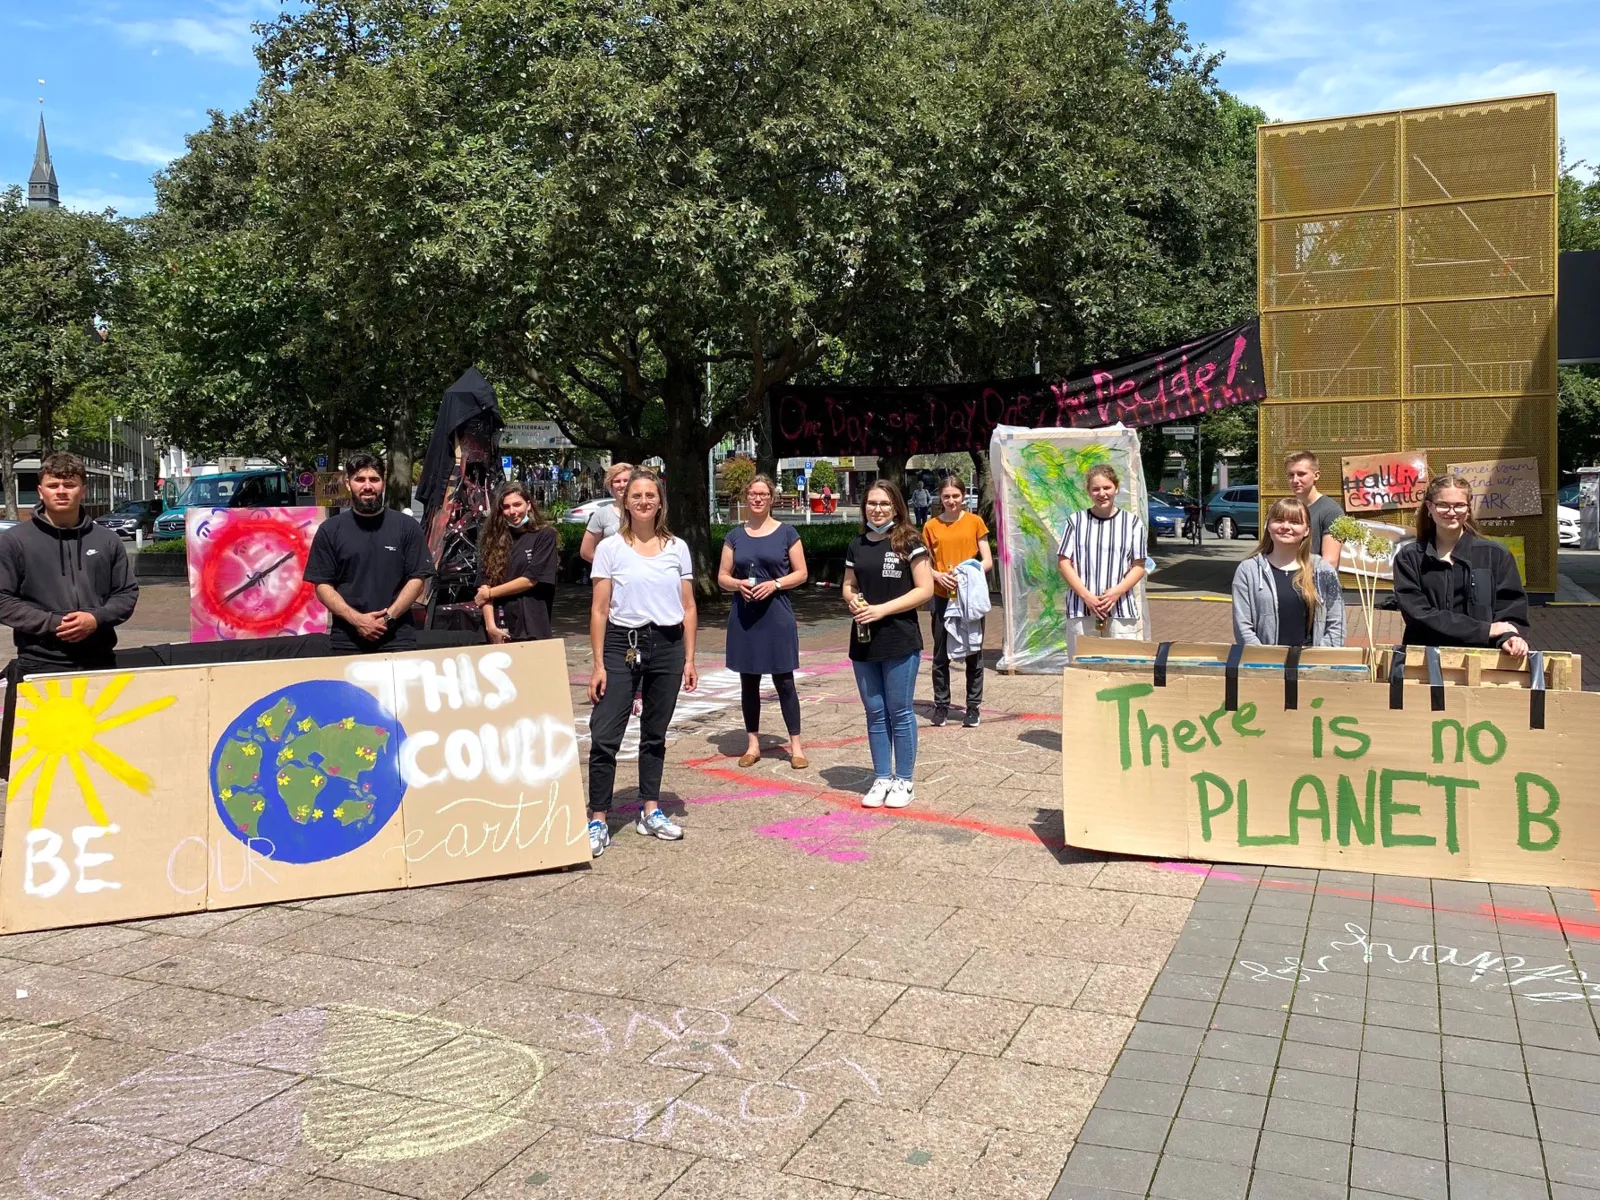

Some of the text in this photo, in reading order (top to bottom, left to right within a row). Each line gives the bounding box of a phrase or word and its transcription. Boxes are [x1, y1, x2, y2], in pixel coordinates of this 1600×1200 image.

[1093, 335, 1246, 424] Decide!
[1349, 486, 1426, 507] esmatte
[1468, 476, 1493, 487] ind
[1469, 493, 1512, 510] TARK
[883, 562, 895, 570] EGO
[345, 651, 518, 717] THIS
[400, 716, 580, 787] COULD
[1096, 682, 1507, 771] There is no
[384, 780, 588, 861] earth
[1191, 767, 1561, 855] PLANET B
[23, 824, 122, 899] BE
[166, 835, 282, 895] OUR
